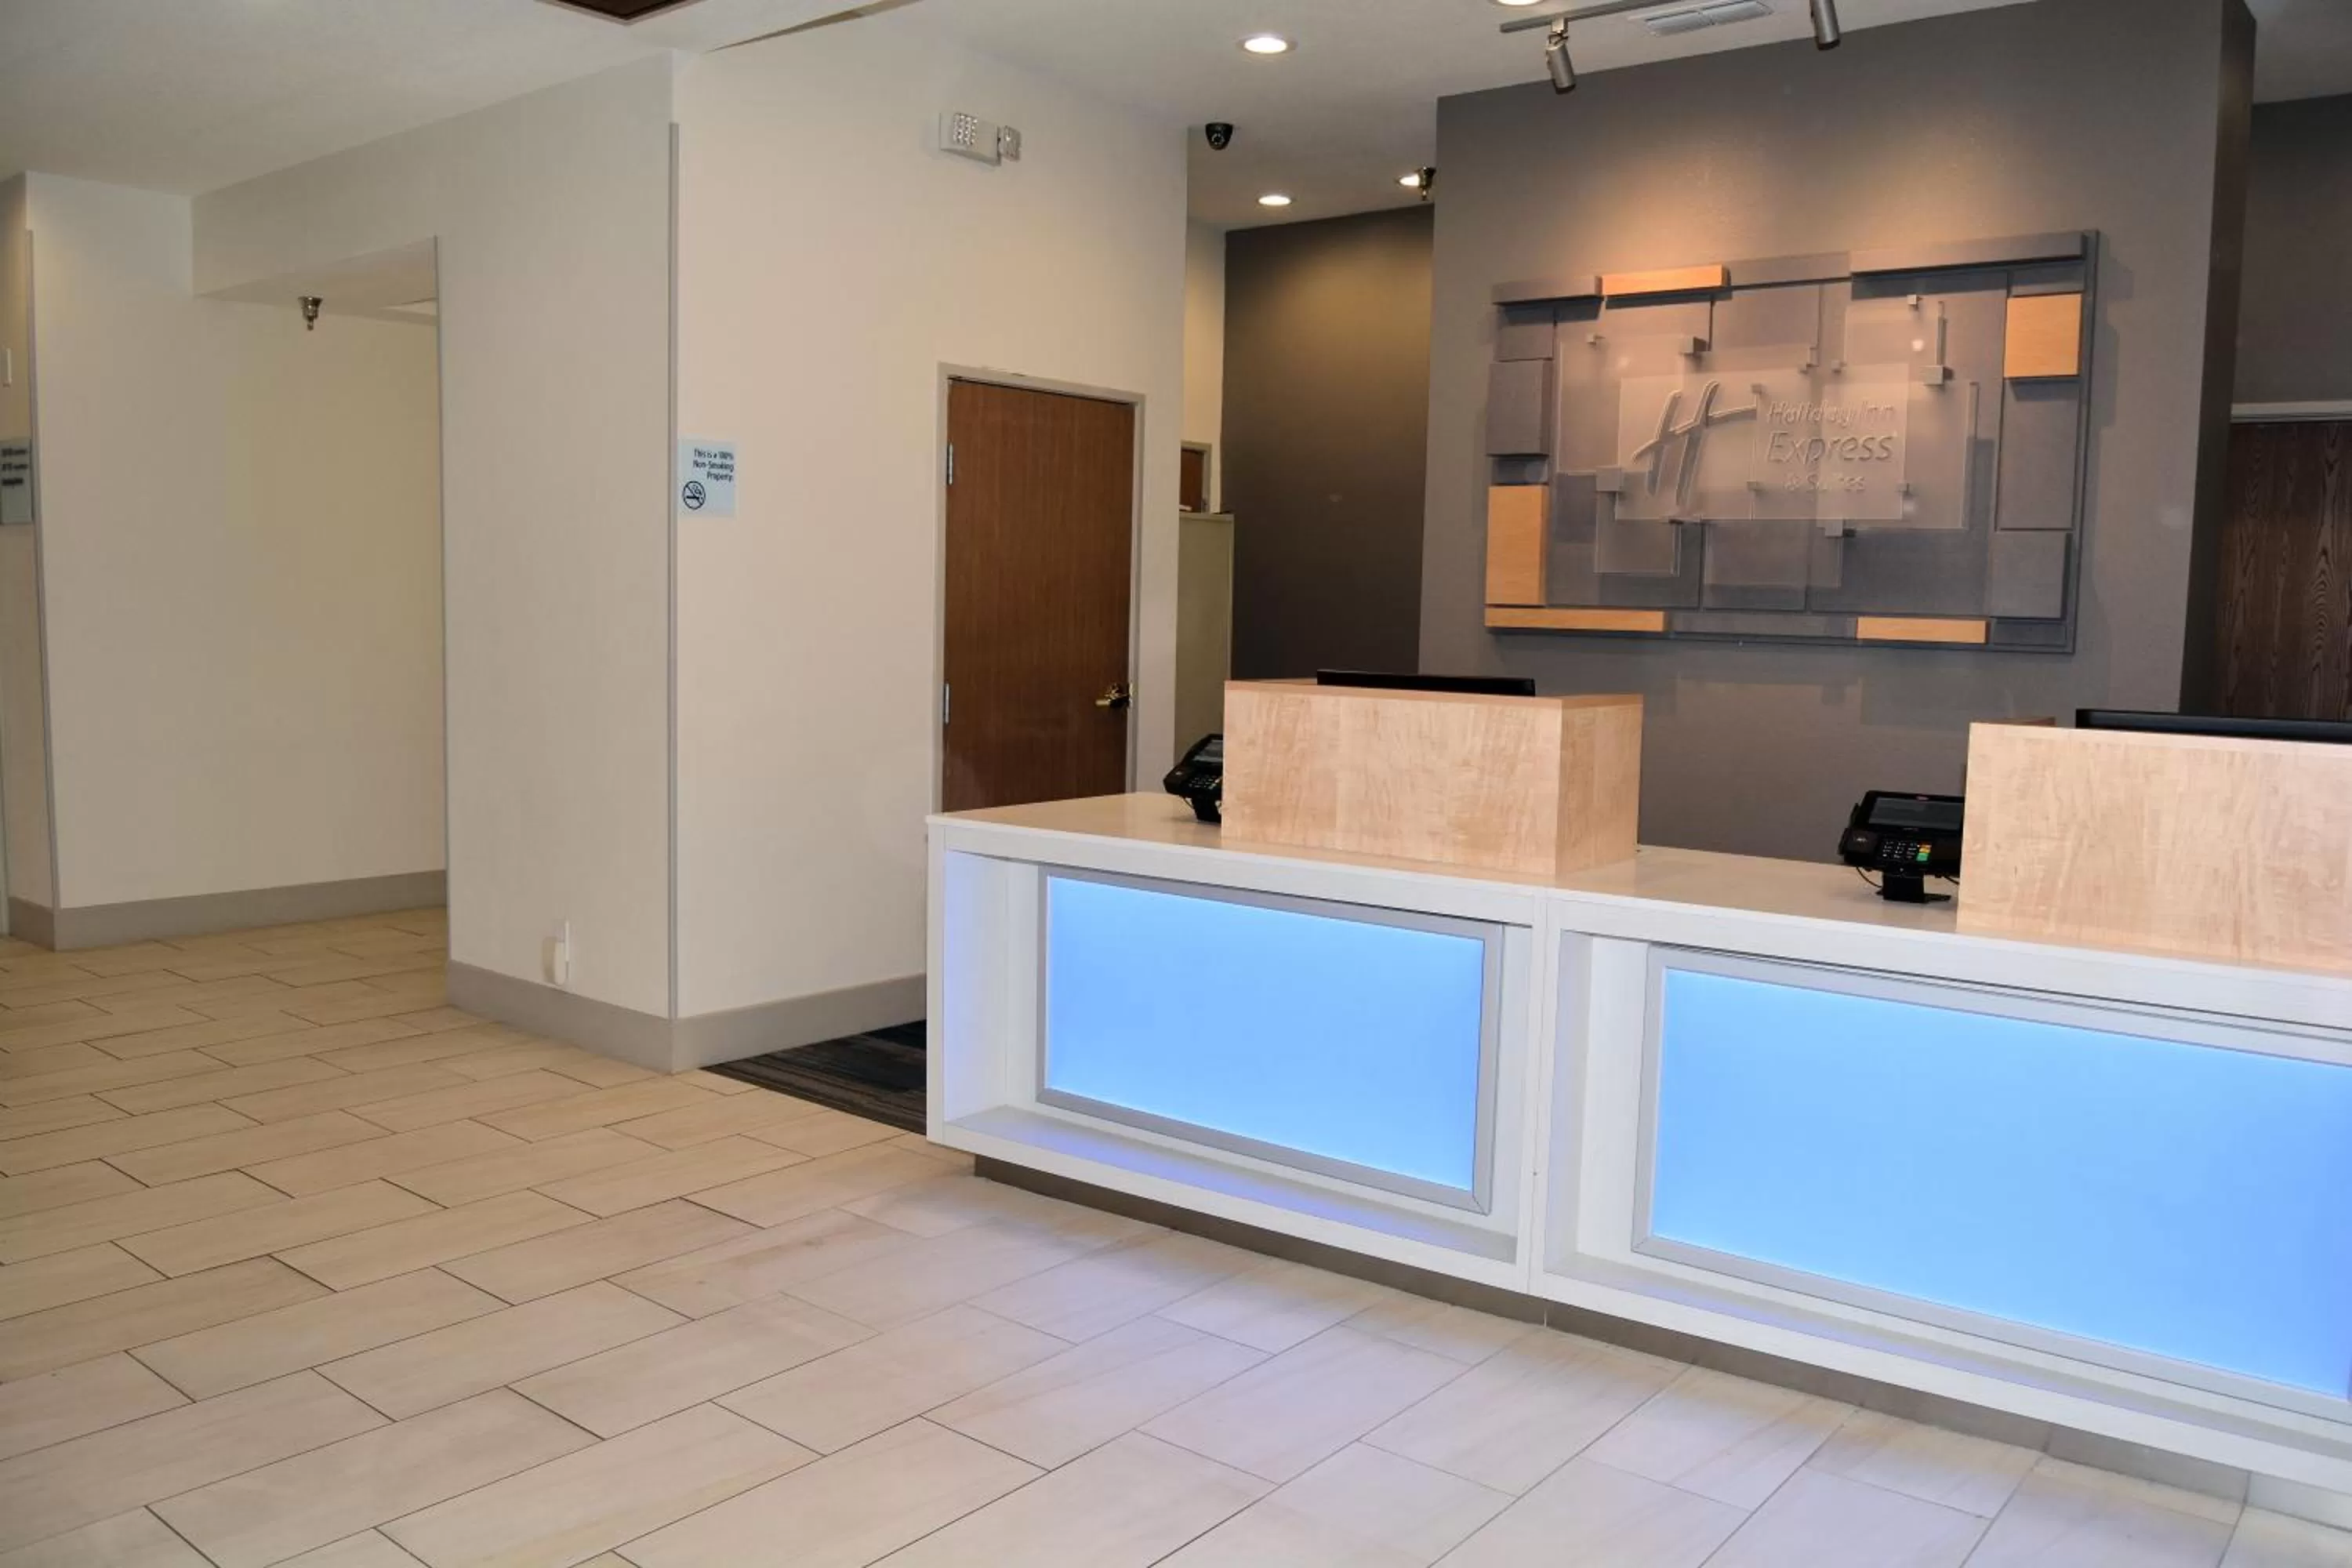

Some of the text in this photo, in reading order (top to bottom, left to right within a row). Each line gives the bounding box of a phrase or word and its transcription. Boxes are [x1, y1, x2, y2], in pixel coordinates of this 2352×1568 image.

[1767, 399, 1896, 428] Holiday Inn
[1767, 430, 1894, 465] Express
[1783, 473, 1866, 493] & Sutes
